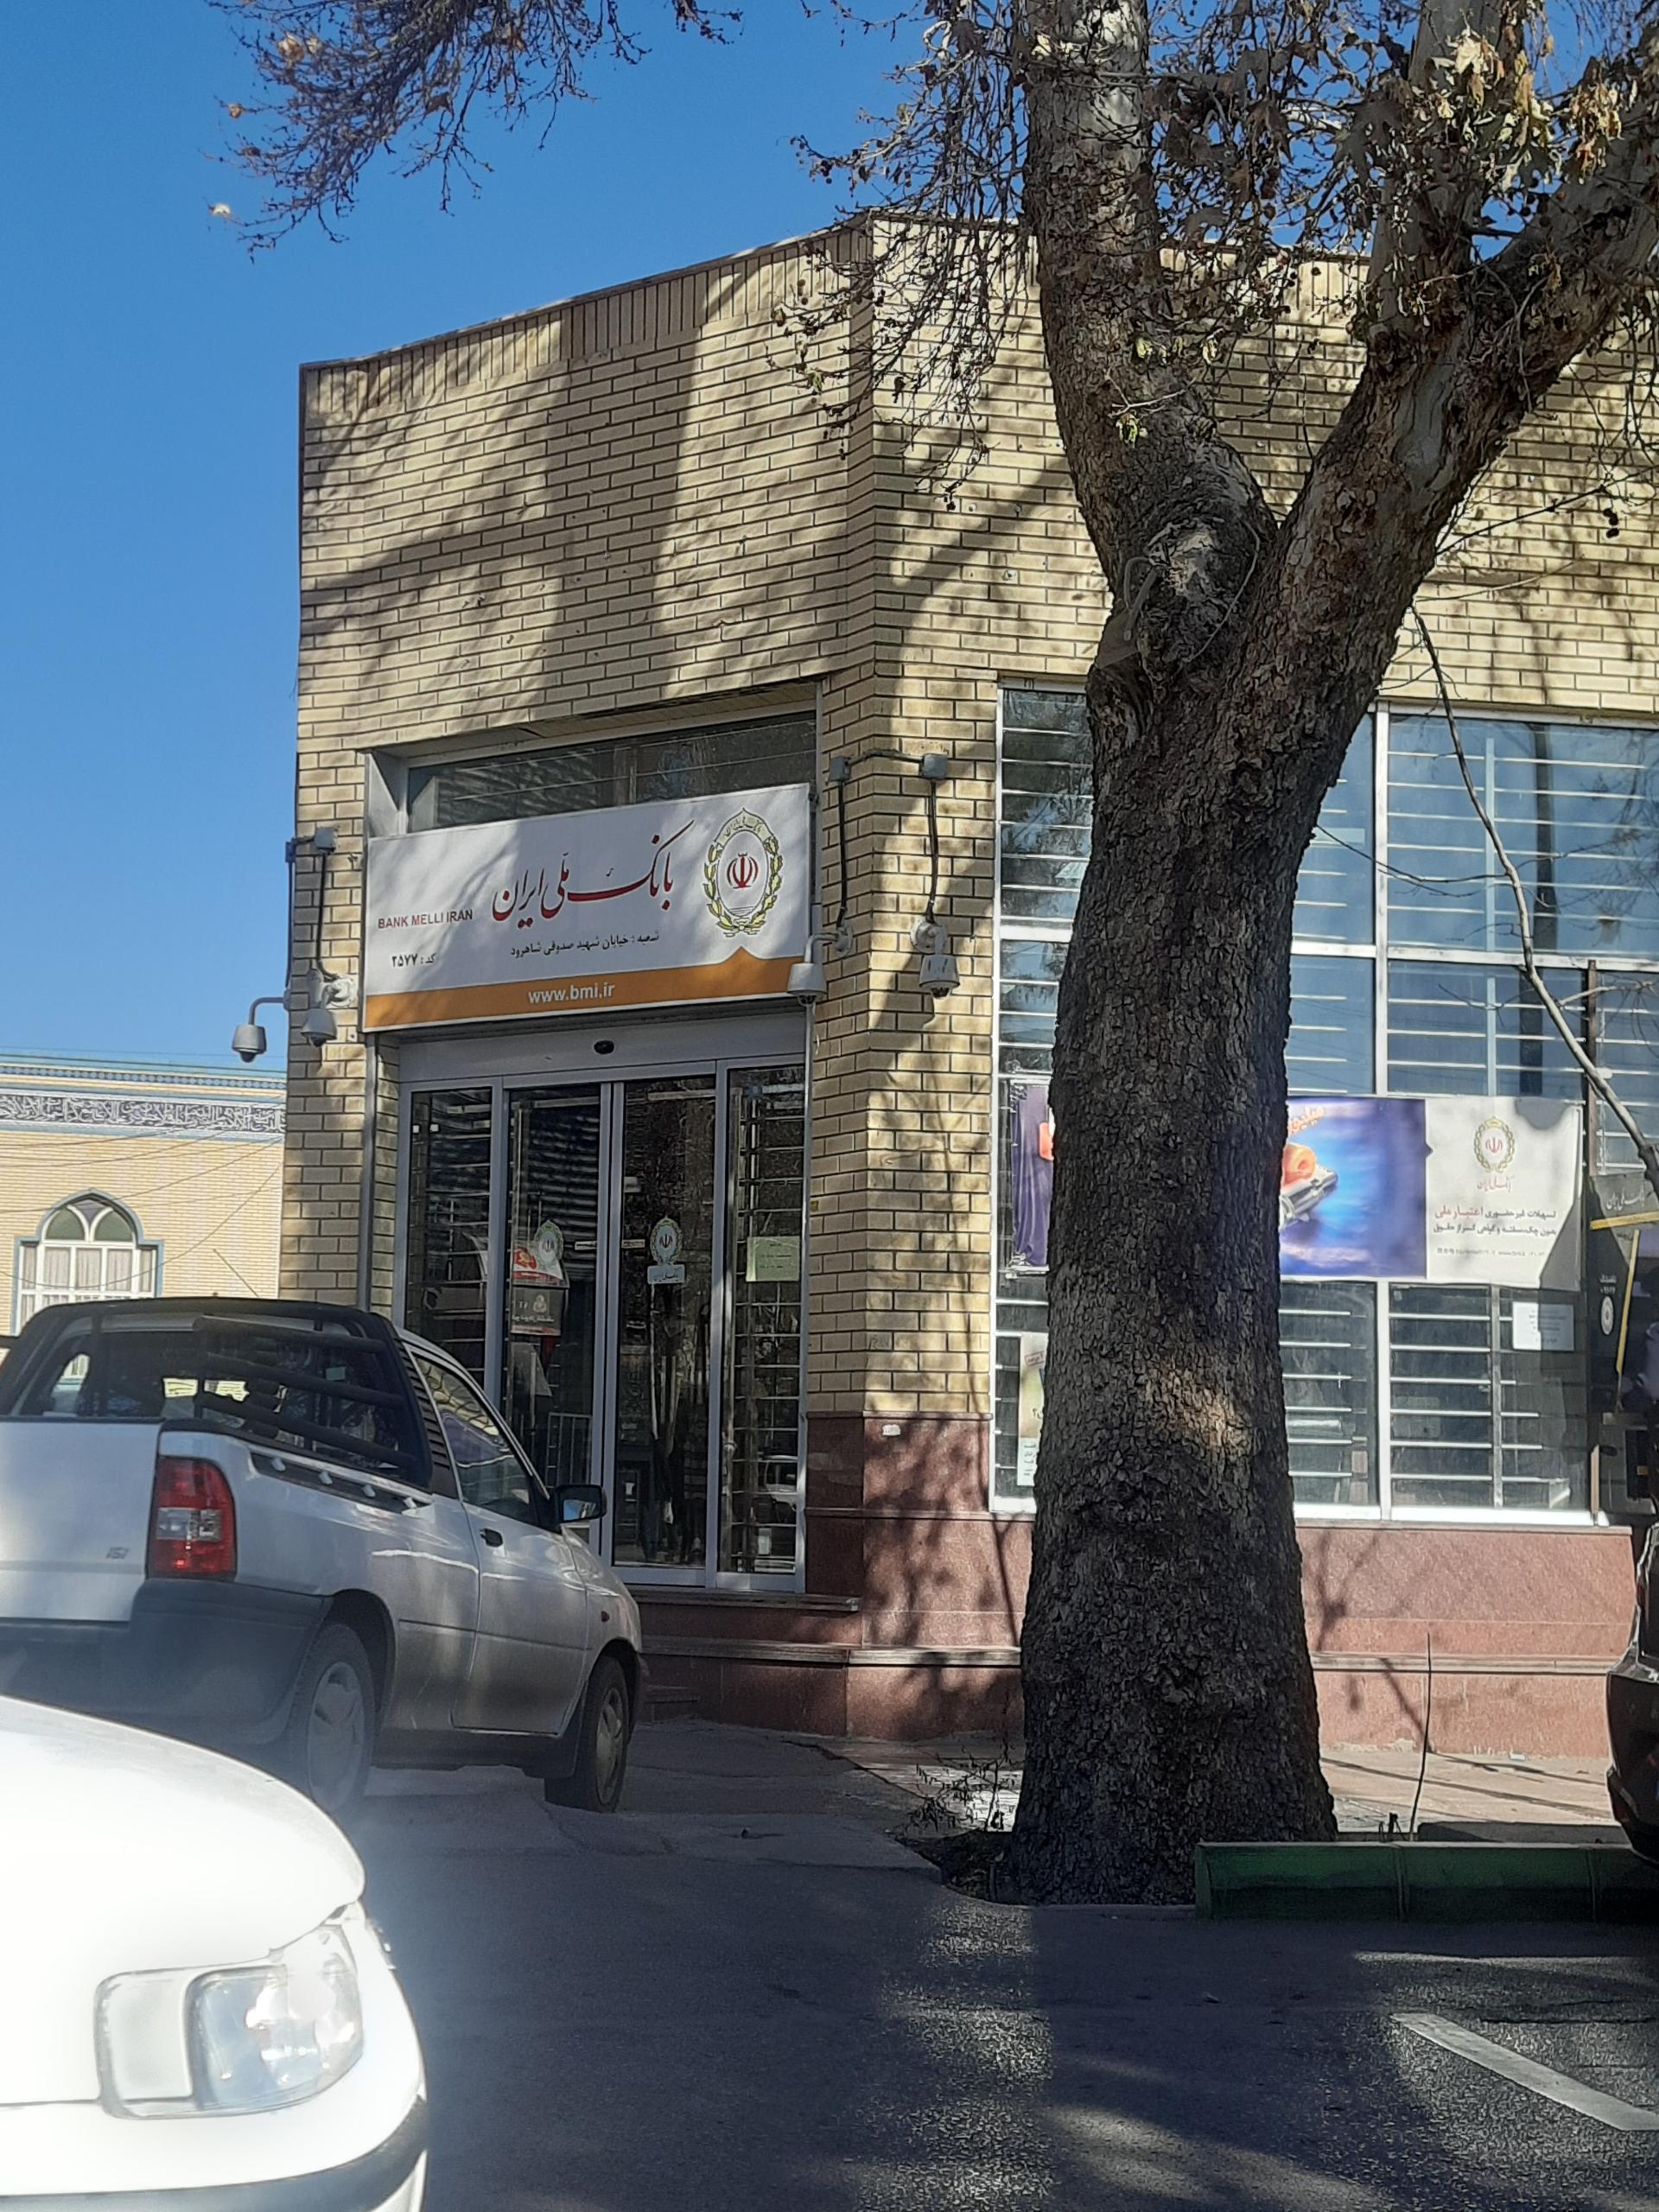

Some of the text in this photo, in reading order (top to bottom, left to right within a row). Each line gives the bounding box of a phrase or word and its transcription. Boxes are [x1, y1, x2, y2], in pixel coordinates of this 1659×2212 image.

[492, 819, 695, 929] بانک ملی ایران
[378, 908, 473, 929] BANK MELLI IRAN
[543, 941, 575, 956] صدوقی
[576, 936, 600, 951] شهید
[601, 934, 629, 950] خیابان
[511, 942, 542, 959] شاهرود
[391, 953, 418, 967] ۲۵۷۷
[528, 982, 616, 1004] www.bmi.ir
